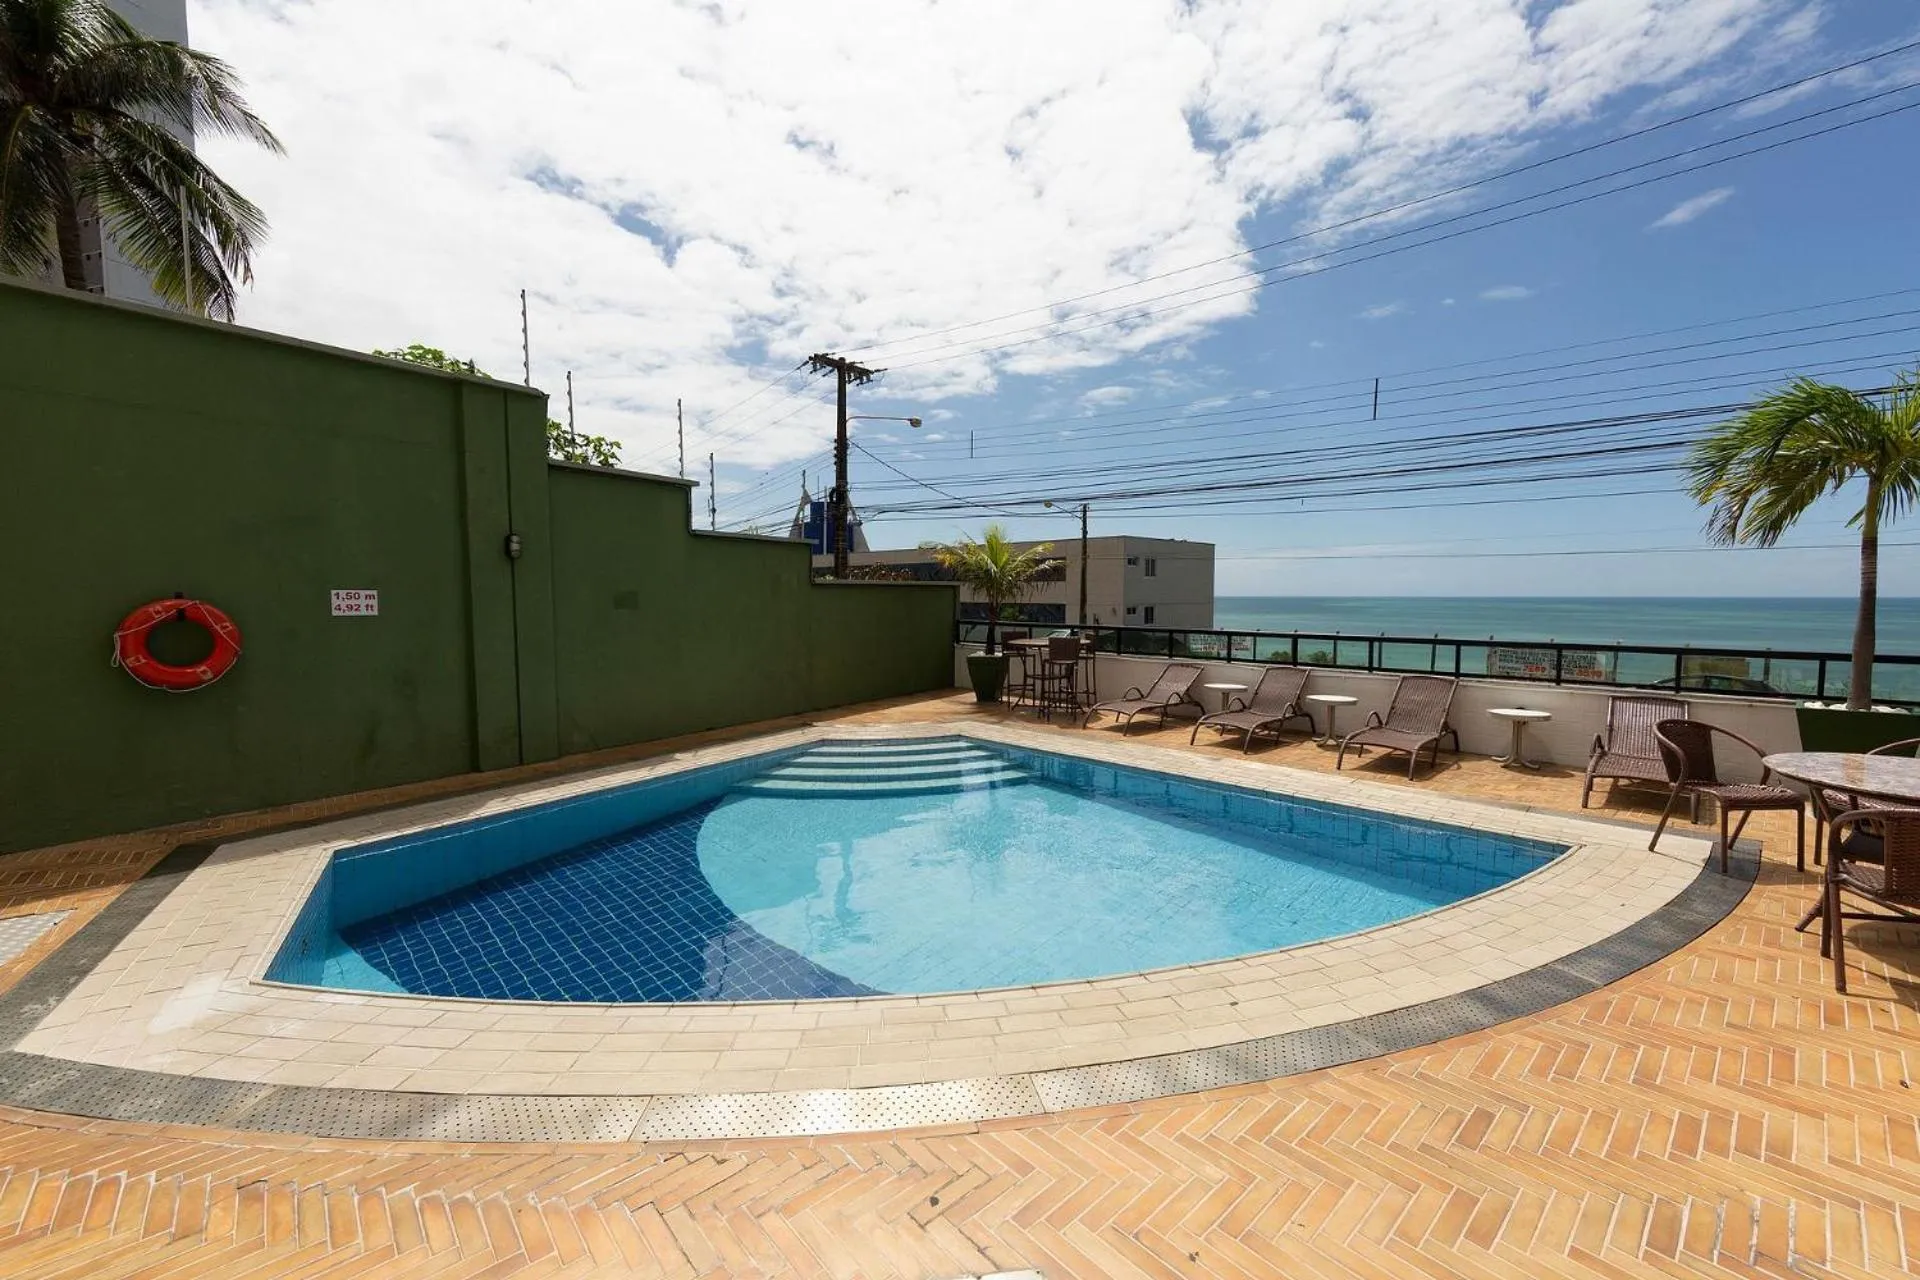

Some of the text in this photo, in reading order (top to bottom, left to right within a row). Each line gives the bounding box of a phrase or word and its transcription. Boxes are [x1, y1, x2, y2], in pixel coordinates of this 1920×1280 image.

[334, 592, 360, 601] 1,50
[334, 604, 374, 613] 4,92 ft
